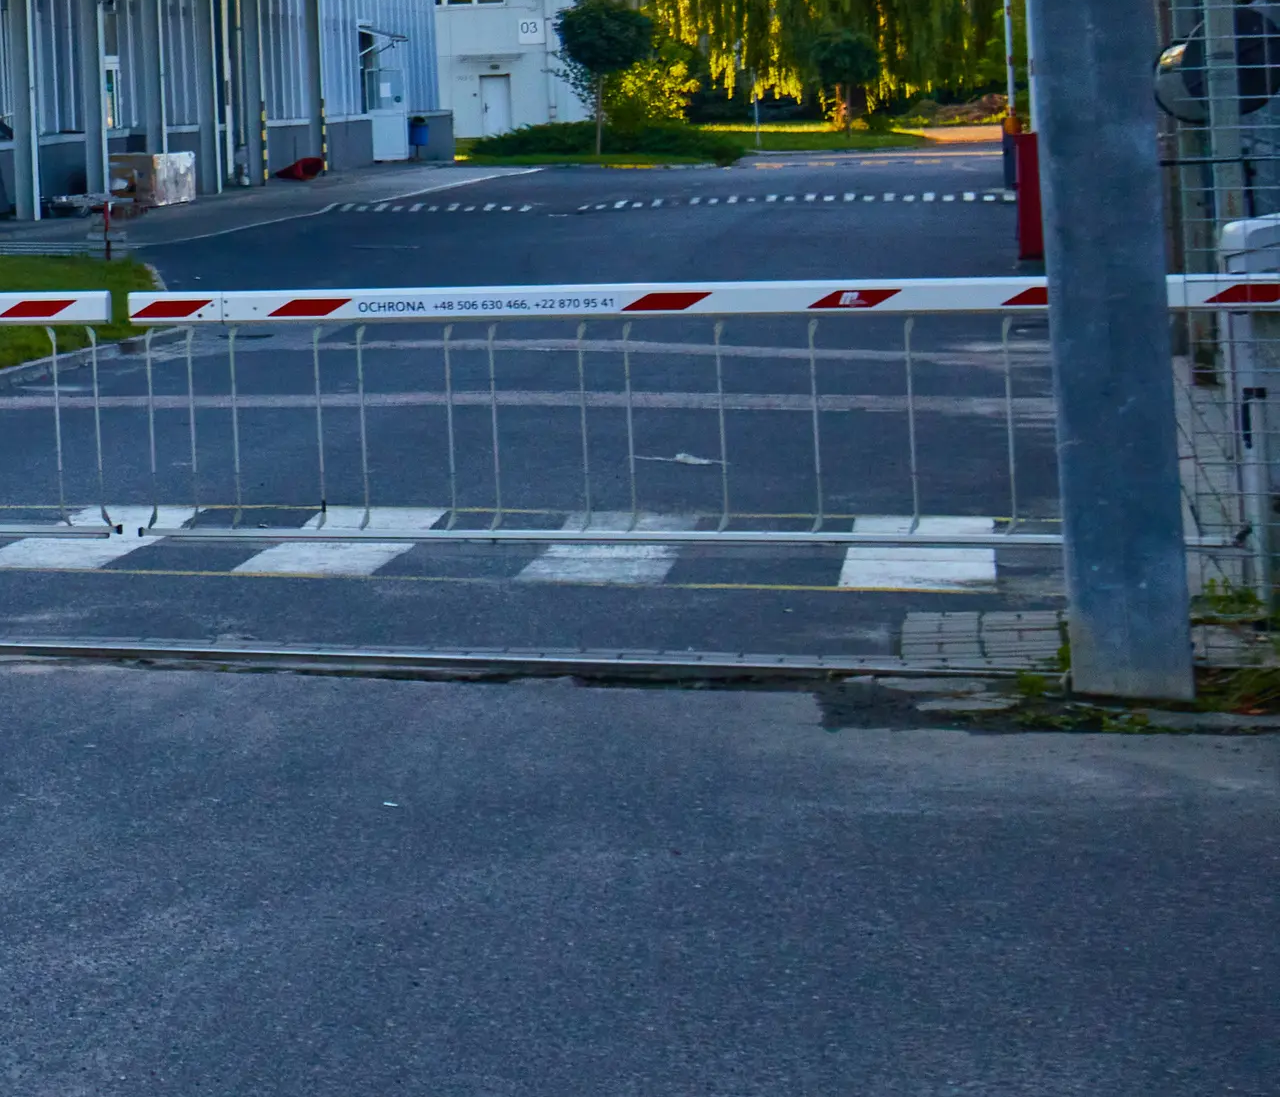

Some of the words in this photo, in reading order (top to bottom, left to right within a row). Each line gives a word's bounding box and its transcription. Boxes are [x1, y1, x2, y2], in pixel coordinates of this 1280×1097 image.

[520, 22, 538, 34] 03
[358, 301, 425, 313] OCHRONA
[433, 301, 454, 311] +48
[457, 301, 478, 311] 506
[481, 300, 501, 310] 630
[534, 299, 555, 309] +22
[558, 298, 580, 308] 870
[583, 298, 598, 308] 95
[600, 298, 615, 307] 41
